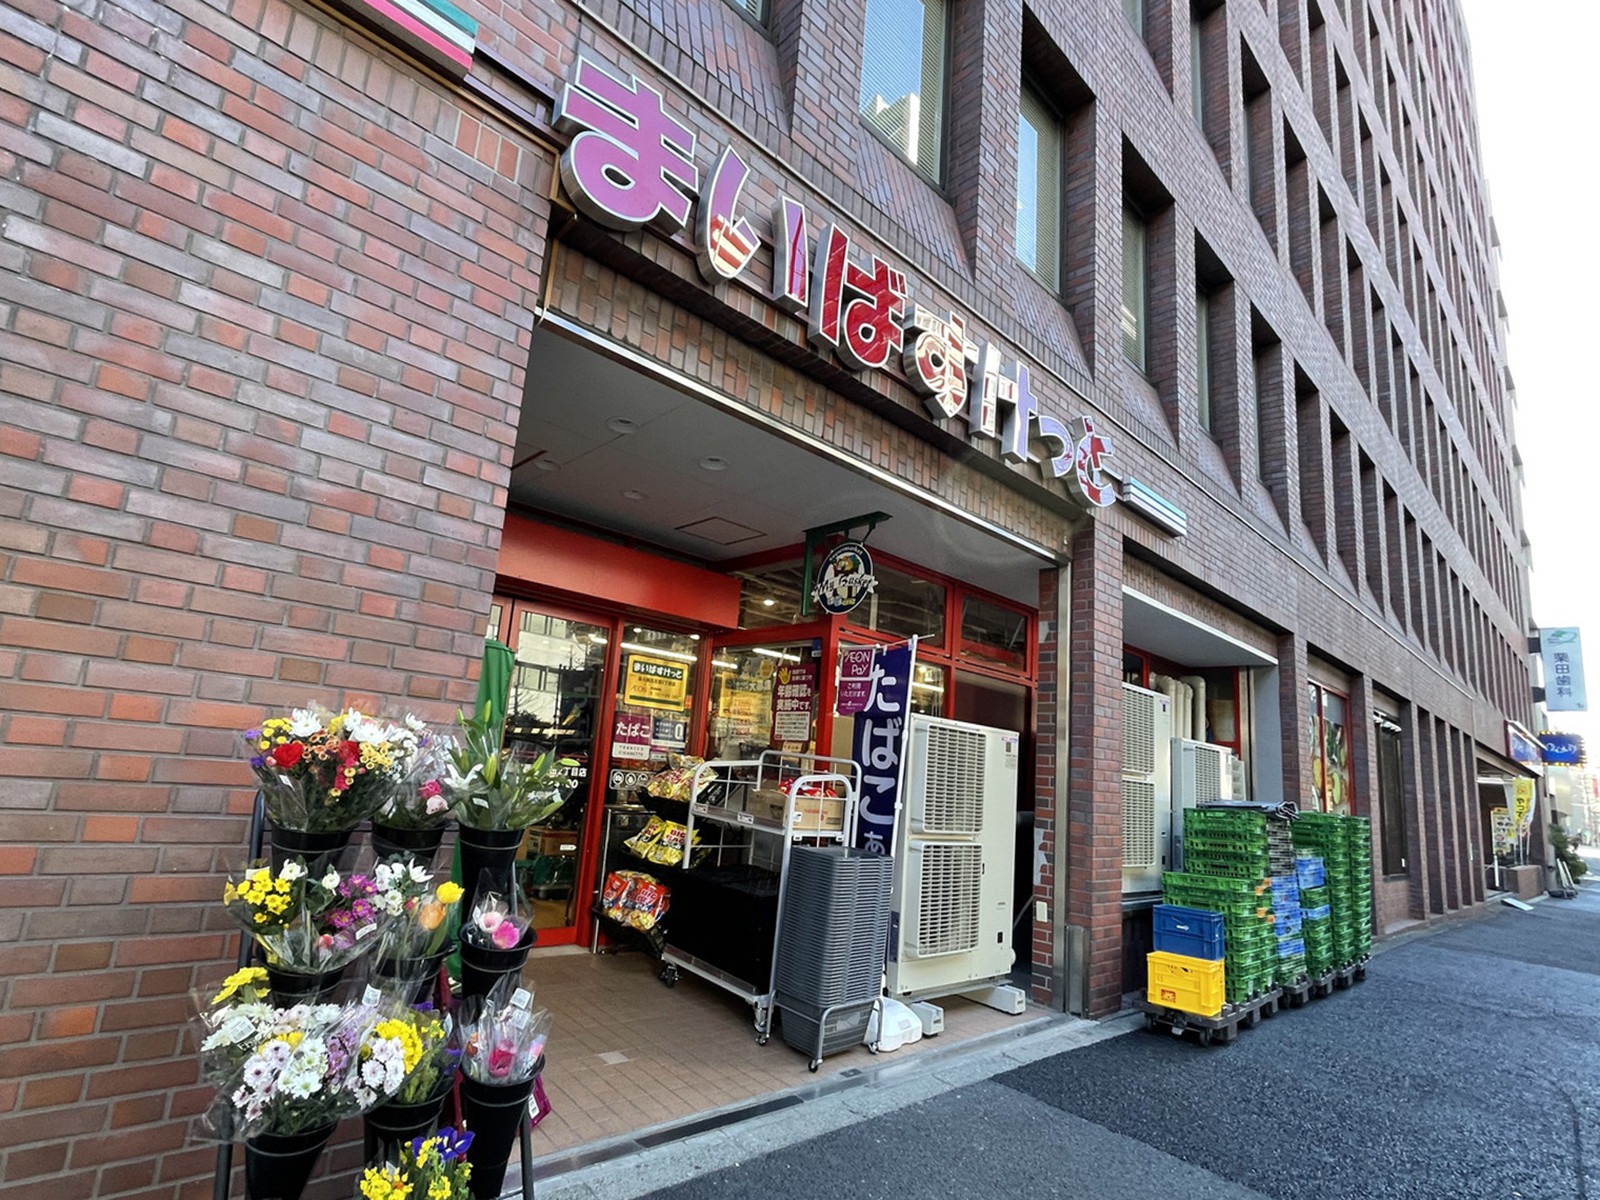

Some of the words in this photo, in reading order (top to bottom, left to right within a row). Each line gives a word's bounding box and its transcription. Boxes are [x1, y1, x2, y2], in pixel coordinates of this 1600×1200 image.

[552, 55, 1117, 508] まいばすけっと
[633, 662, 683, 679] まいばすけっと
[1553, 652, 1572, 698] 栗田歯科
[777, 684, 811, 698] 年齢確認を
[616, 721, 651, 738] たばこ
[859, 663, 903, 826] たばこ
